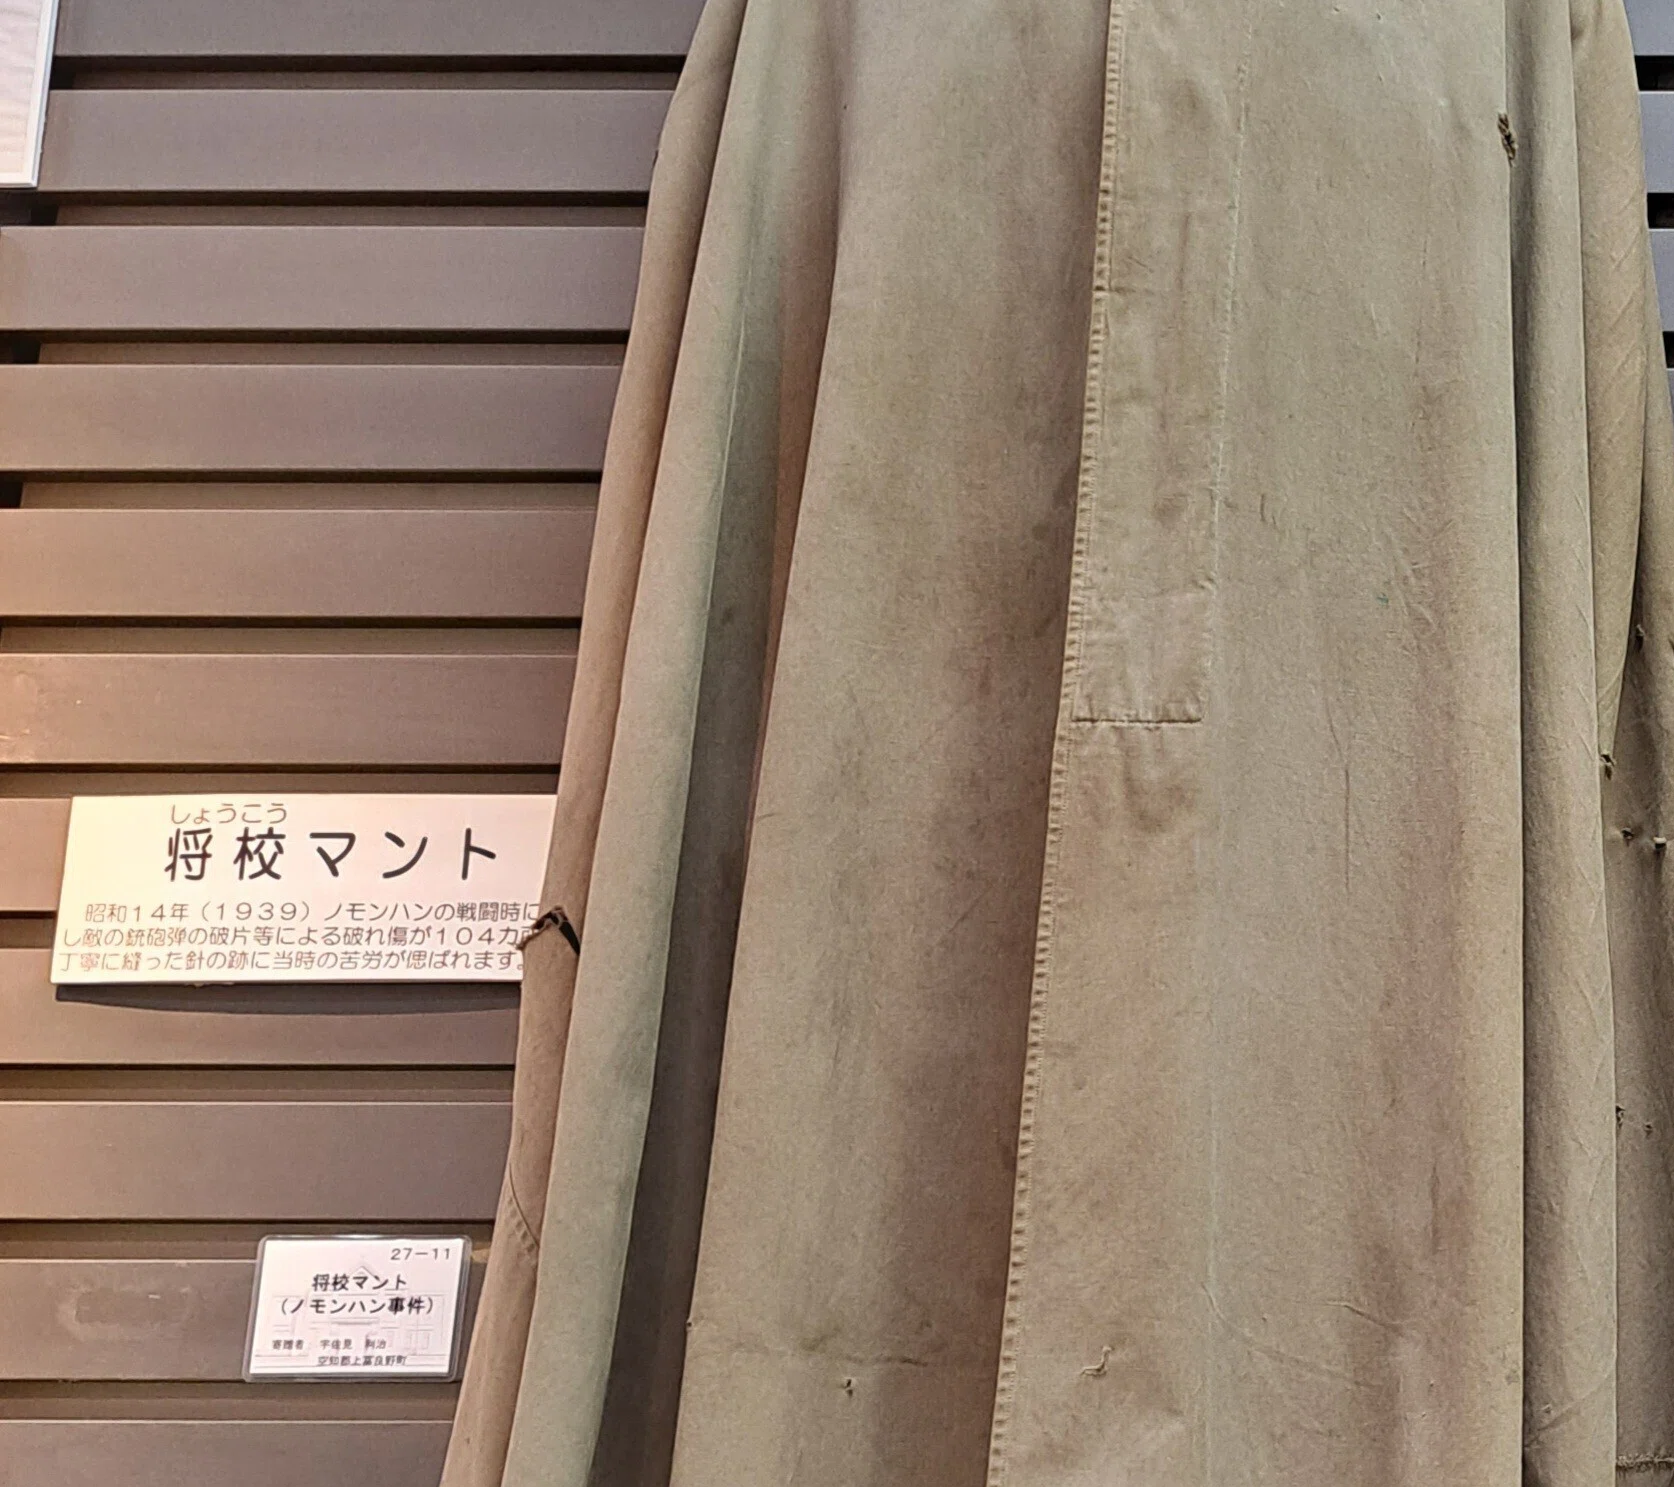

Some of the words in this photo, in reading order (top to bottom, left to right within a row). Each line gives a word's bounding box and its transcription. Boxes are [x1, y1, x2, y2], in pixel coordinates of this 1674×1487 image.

[169, 803, 288, 825] しょうこう
[164, 827, 497, 882] 将校マント
[390, 1247, 451, 1261] 27-11
[311, 1273, 408, 1291] 将校マント
